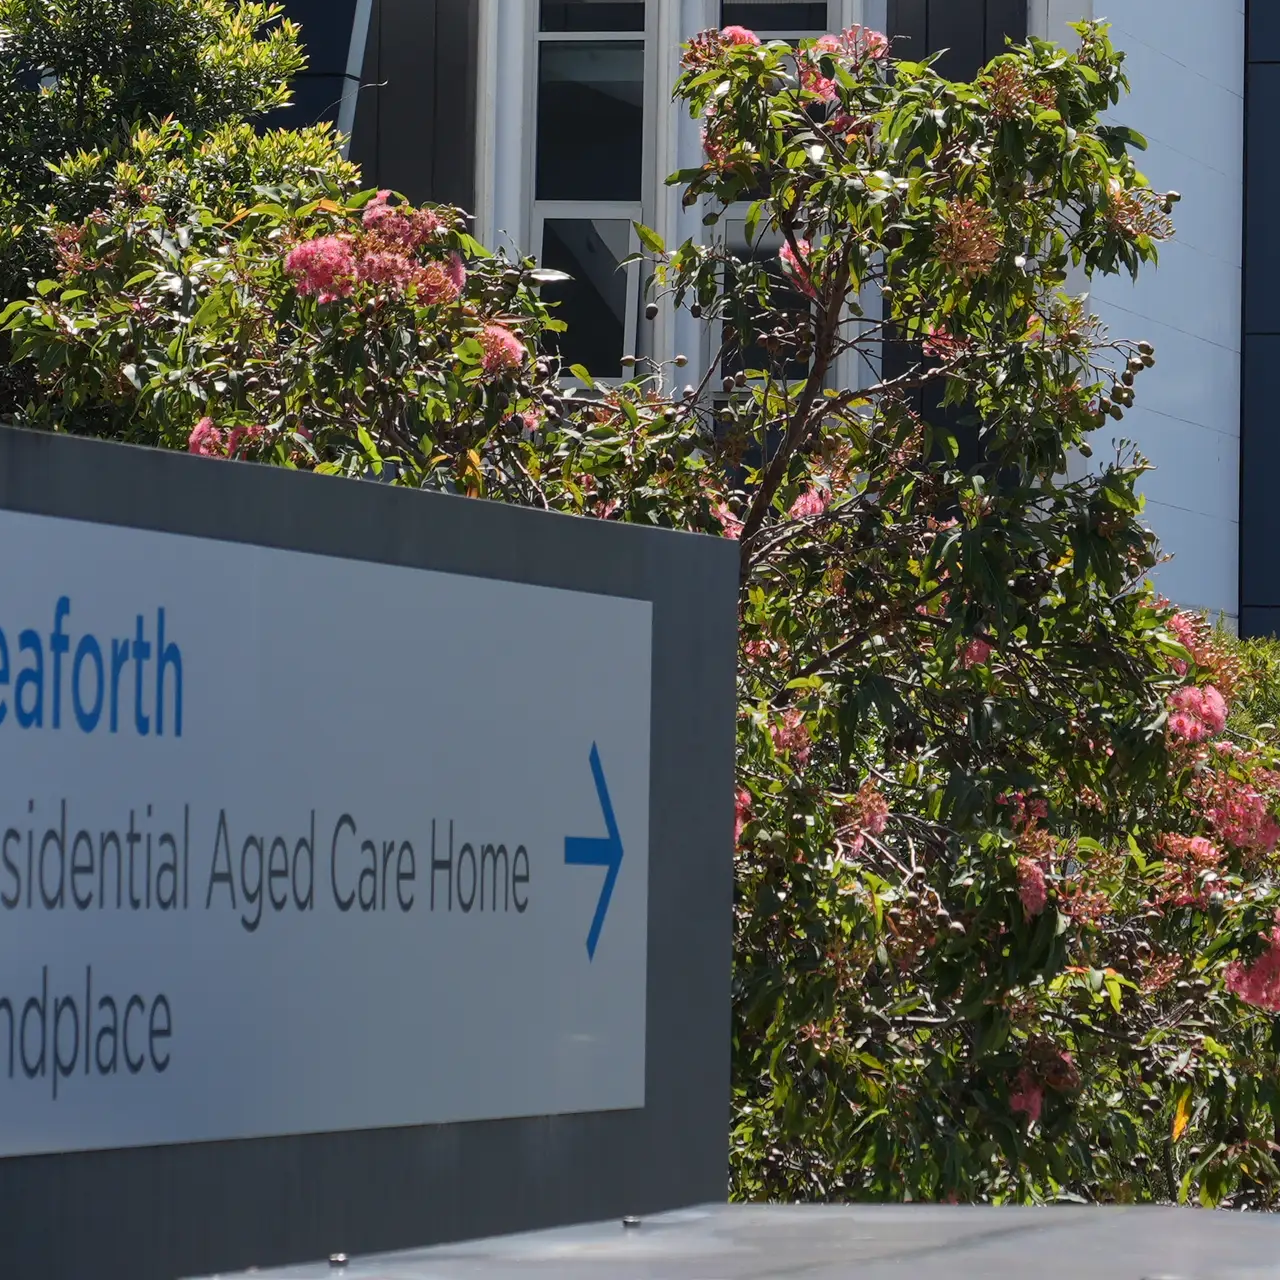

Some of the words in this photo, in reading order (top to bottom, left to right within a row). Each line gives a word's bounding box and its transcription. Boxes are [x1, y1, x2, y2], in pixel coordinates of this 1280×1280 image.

[206, 808, 315, 933] Aged
[331, 812, 416, 913] Care
[431, 818, 530, 913] Home
